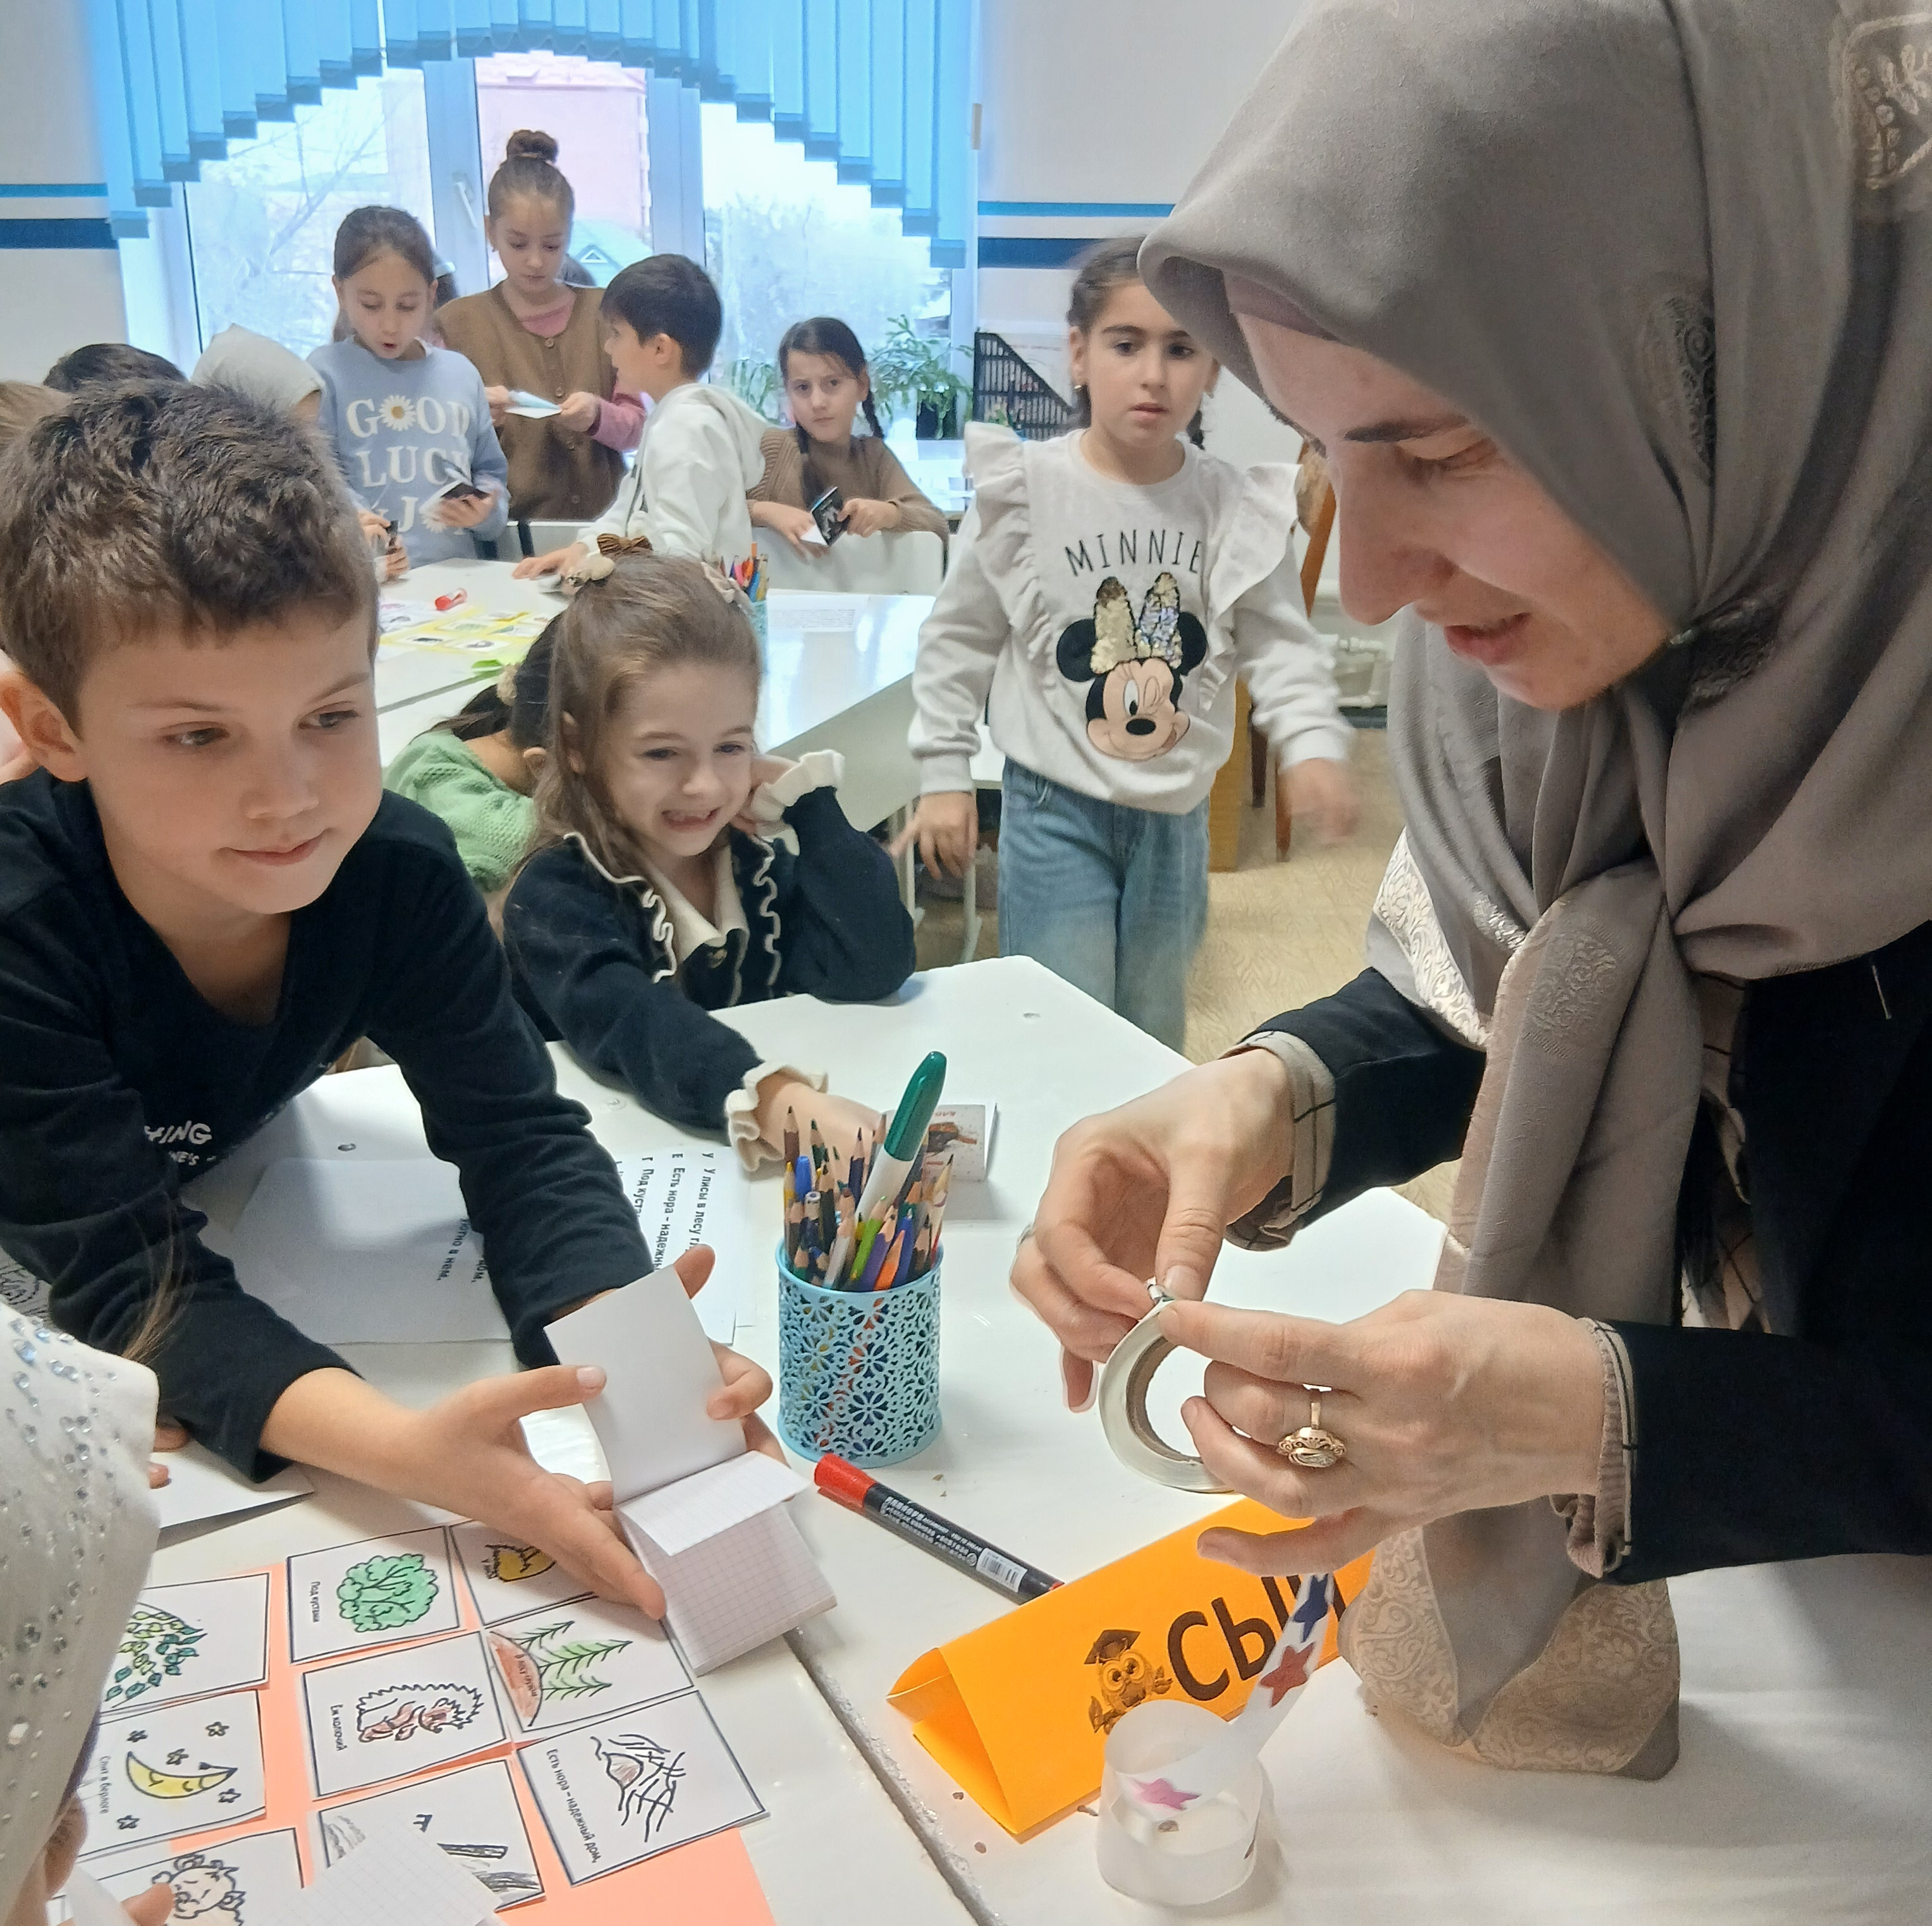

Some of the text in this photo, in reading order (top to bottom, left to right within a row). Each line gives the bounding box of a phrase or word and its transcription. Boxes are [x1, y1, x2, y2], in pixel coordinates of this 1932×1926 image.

[1065, 528, 1202, 576] MINNIE
[638, 1169, 654, 1186] Под
[670, 1167, 685, 1188] Есть
[699, 1176, 711, 1200] лисы
[664, 1190, 678, 1214] нора
[689, 1211, 704, 1234] лесу
[654, 1224, 671, 1272] надежны
[546, 1748, 560, 1769] Есть
[554, 1769, 570, 1791] нора
[566, 1798, 596, 1841] надежный
